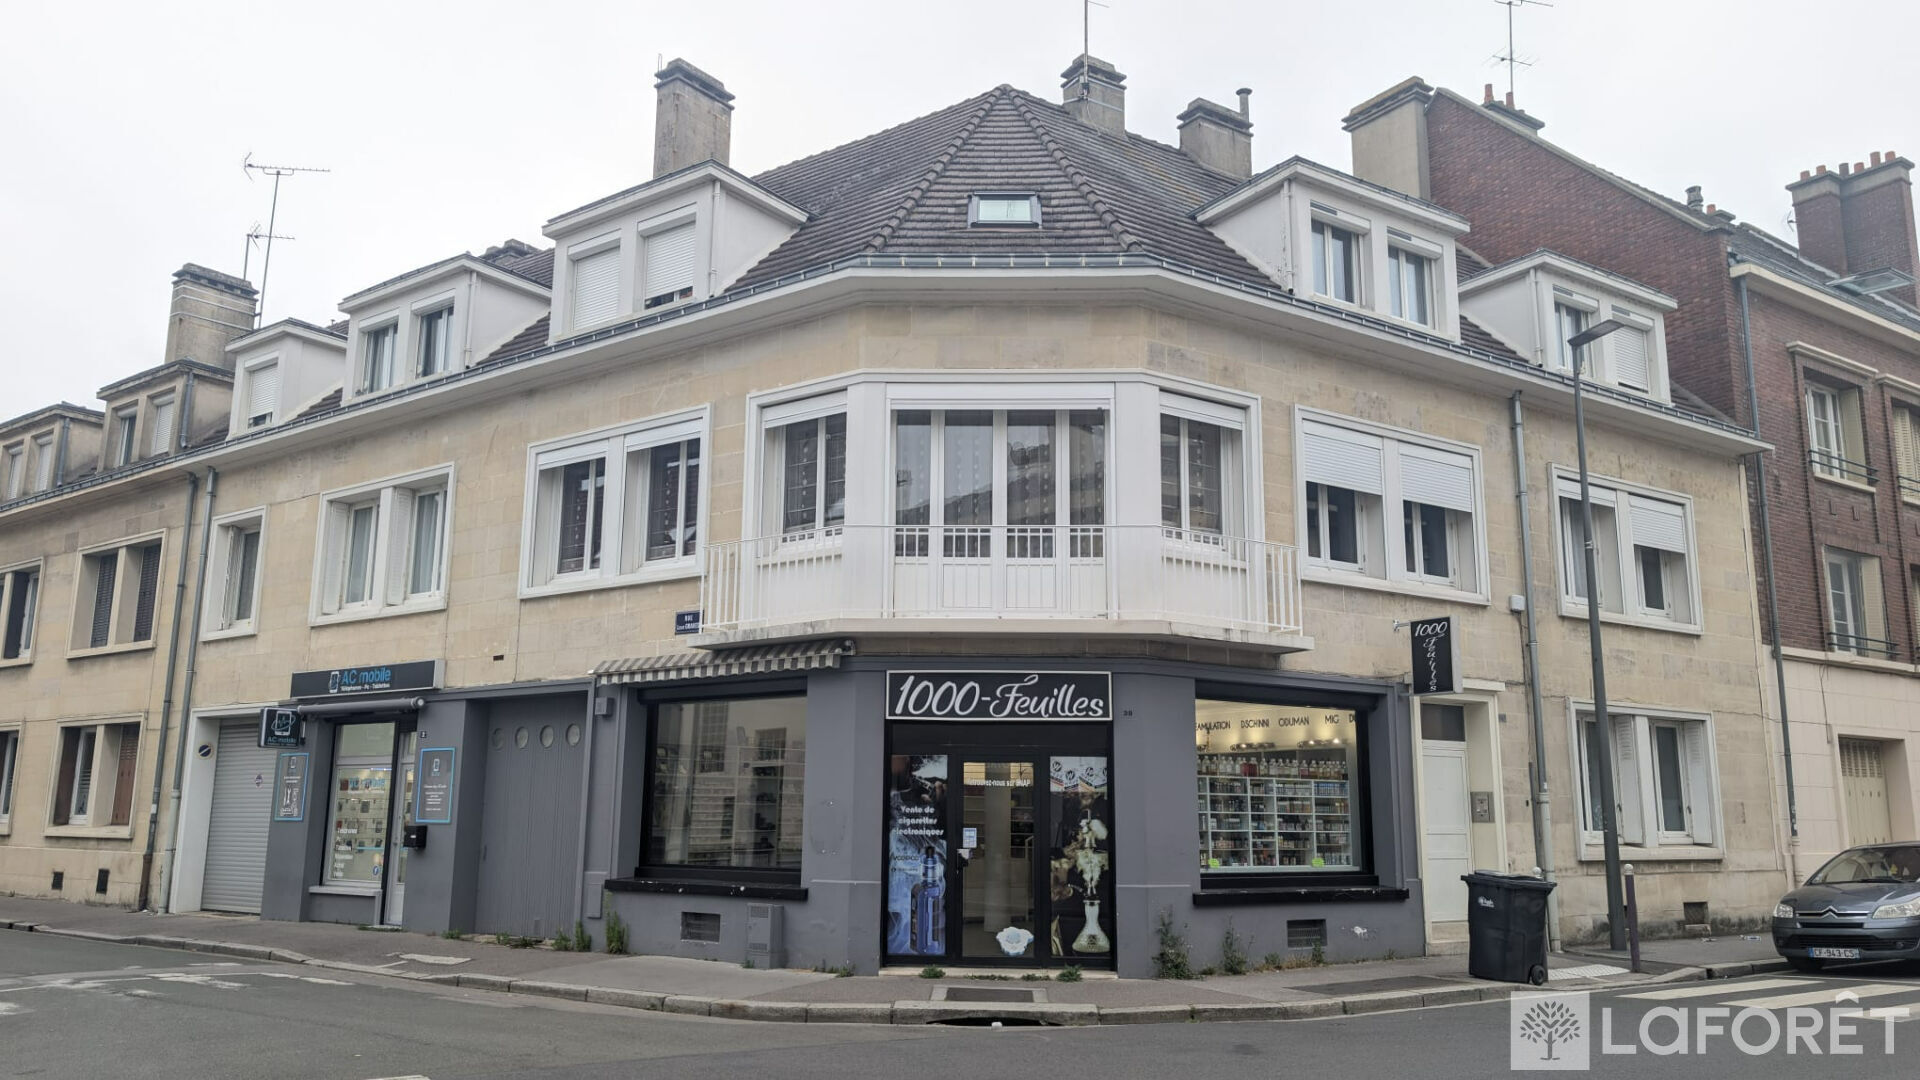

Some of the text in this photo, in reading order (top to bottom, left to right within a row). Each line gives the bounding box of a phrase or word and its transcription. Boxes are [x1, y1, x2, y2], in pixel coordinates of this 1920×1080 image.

[1415, 621, 1448, 637] 1000
[1423, 633, 1446, 692] Feuilles
[341, 666, 392, 685] AC mobile
[895, 674, 1104, 717] 1000-Feuilles
[1325, 714, 1340, 724] MIG
[900, 805, 935, 814] Vente de
[898, 817, 938, 826] cigarettes
